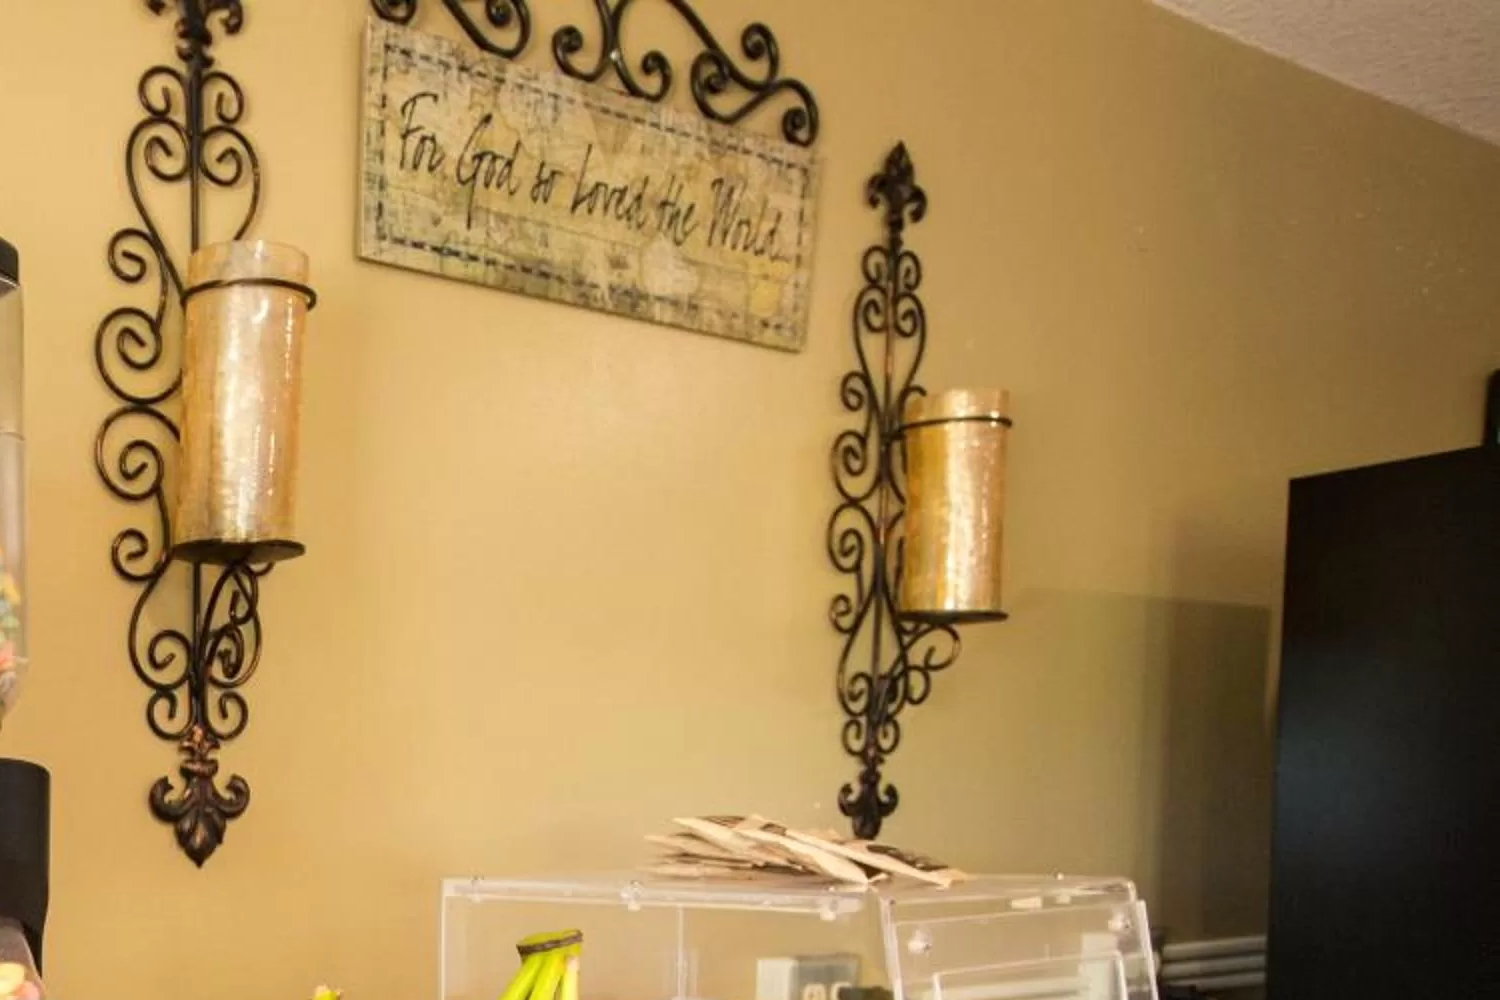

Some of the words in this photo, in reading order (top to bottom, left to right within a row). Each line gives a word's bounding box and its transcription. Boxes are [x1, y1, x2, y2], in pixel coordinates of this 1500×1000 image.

[399, 92, 444, 173] For
[455, 113, 522, 230] God
[531, 162, 562, 203] so
[655, 173, 698, 246] the
[707, 176, 800, 261] World
